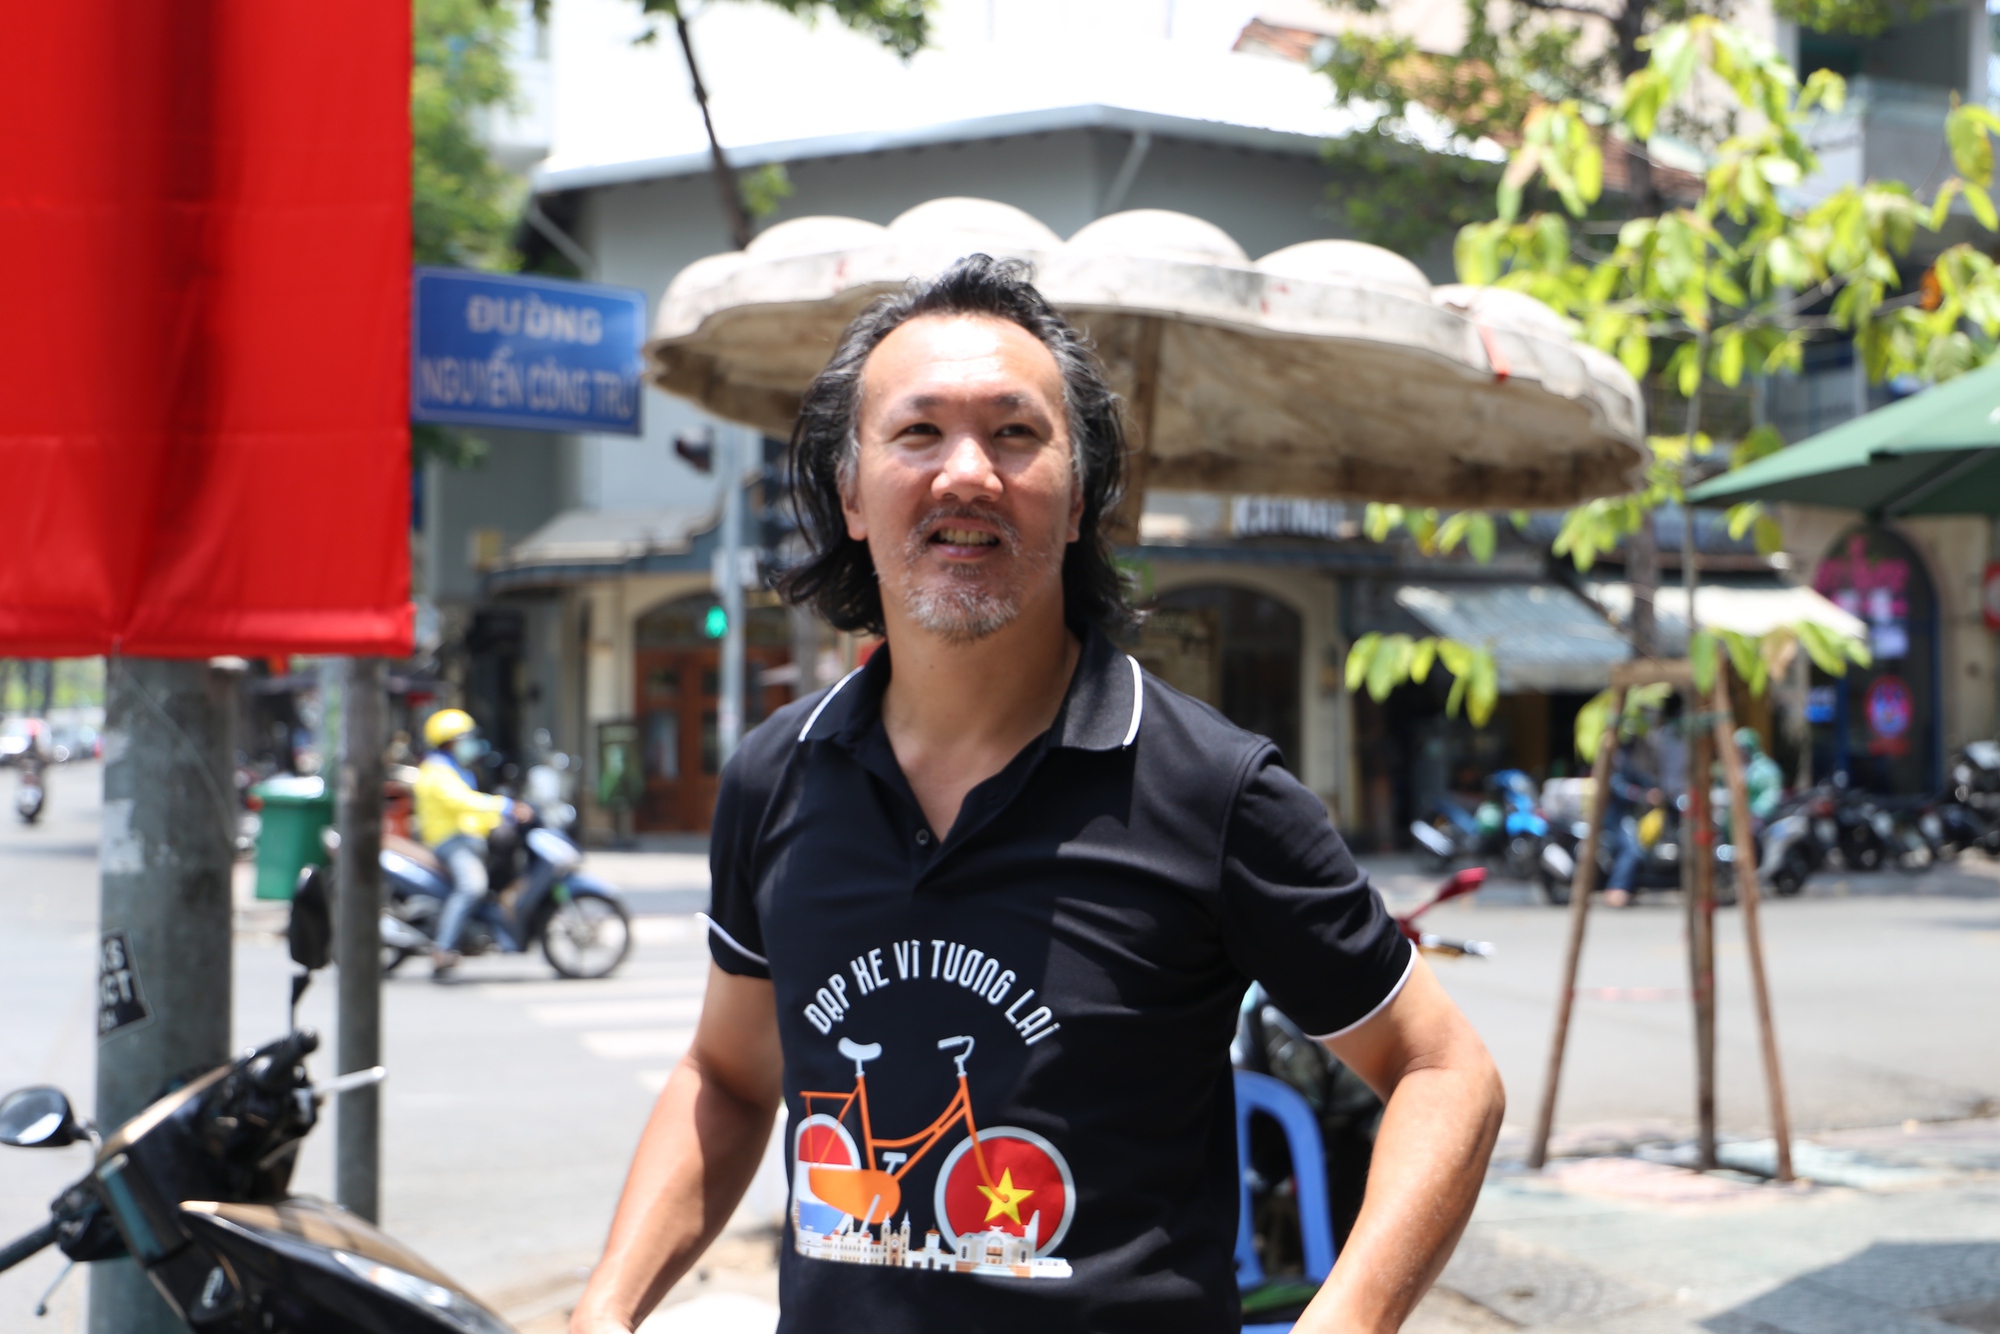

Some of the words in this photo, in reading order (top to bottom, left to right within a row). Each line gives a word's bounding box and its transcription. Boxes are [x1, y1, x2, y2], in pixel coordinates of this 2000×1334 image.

[803, 973, 850, 1035] ĐẠP
[849, 947, 890, 996] XE
[931, 939, 1017, 1006] TƯƠNG
